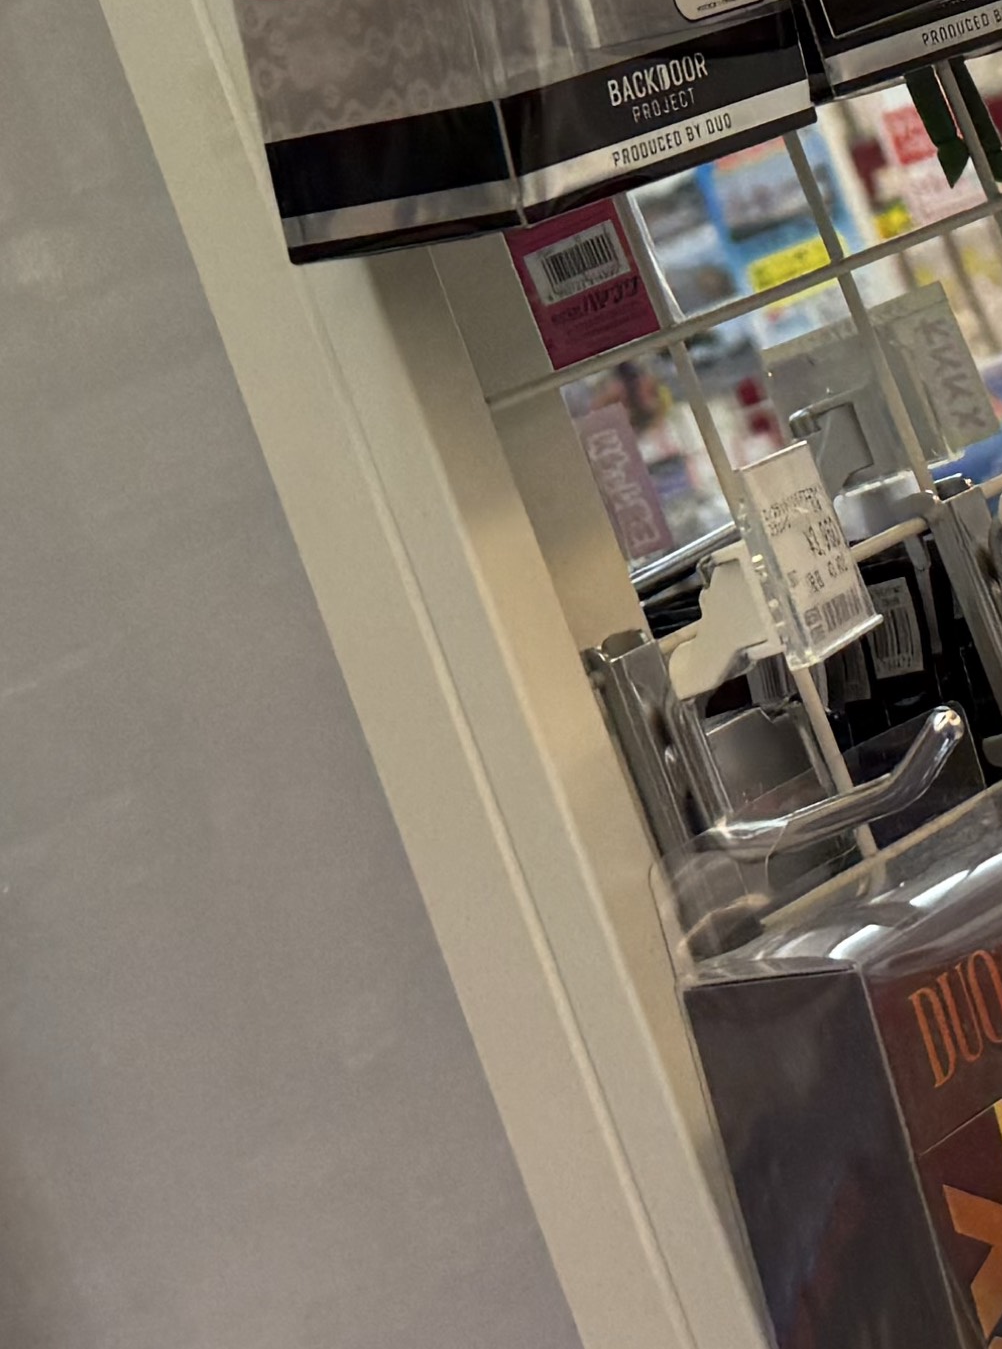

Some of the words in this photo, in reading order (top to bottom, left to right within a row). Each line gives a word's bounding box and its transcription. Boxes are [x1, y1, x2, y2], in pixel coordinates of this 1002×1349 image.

[921, 12, 990, 46] PRODUCED
[607, 52, 709, 107] BACKDOOR
[632, 87, 695, 124] PROJECT
[612, 130, 683, 167] PRODUCED
[685, 124, 701, 143] BY
[705, 112, 732, 136] DUO
